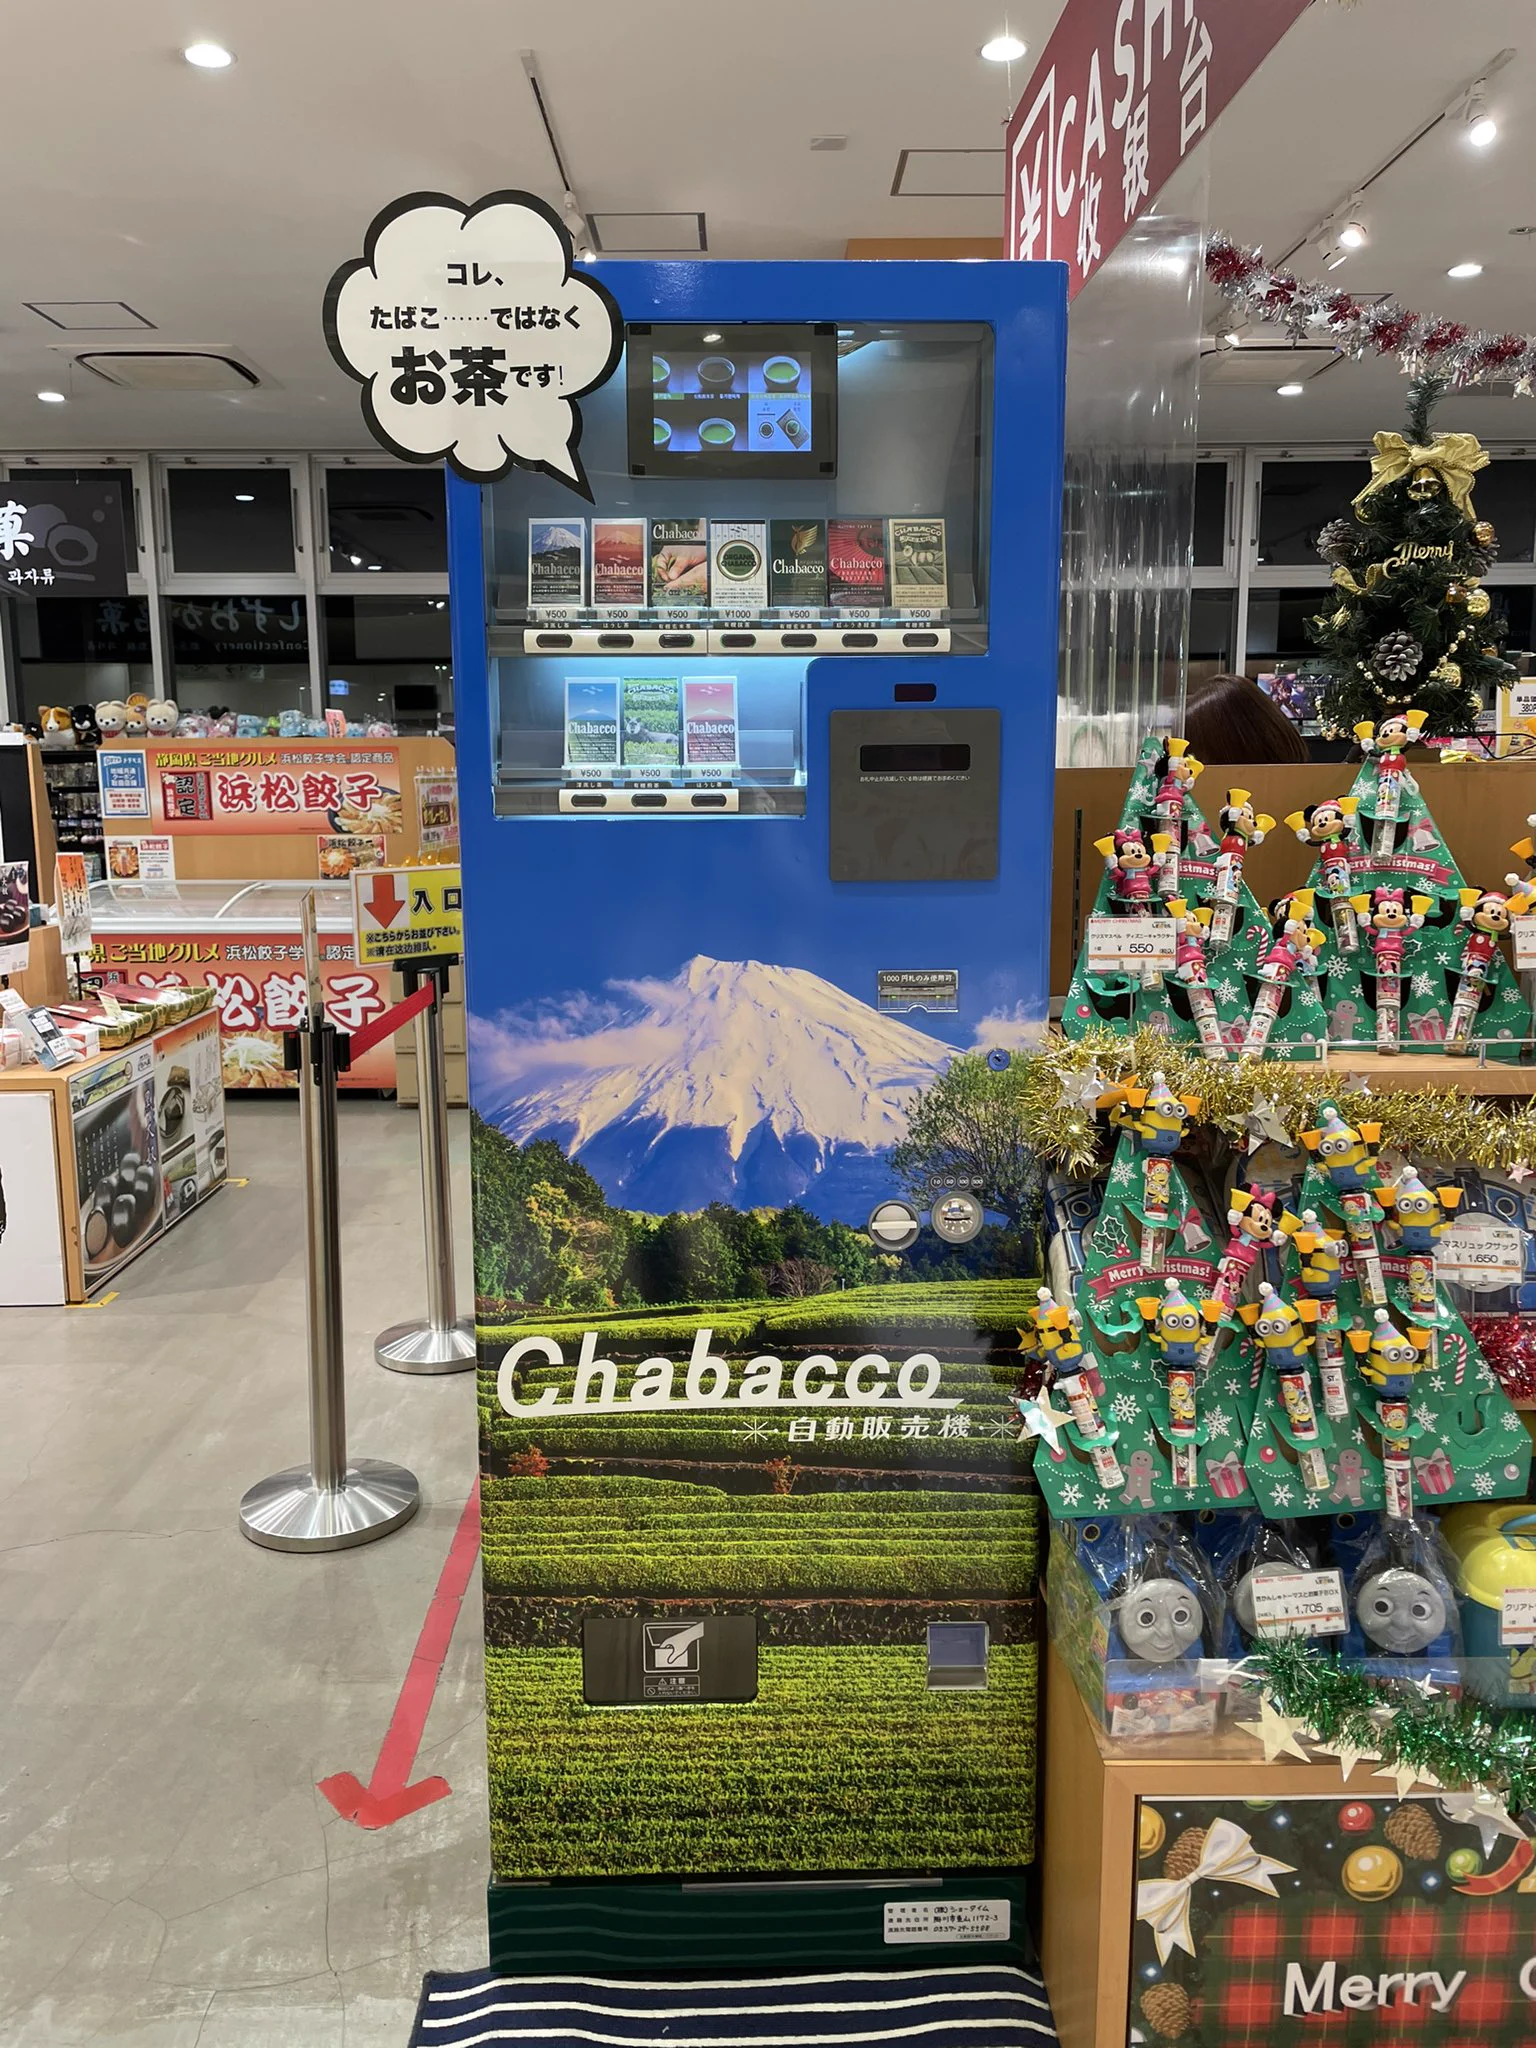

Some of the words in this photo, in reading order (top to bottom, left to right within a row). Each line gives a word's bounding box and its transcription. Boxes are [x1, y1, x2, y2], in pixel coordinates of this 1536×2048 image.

[446, 262, 505, 287] コレ、
[531, 562, 580, 576] Chabacco
[595, 562, 644, 576] Chabacco
[772, 558, 824, 574] Chabacco
[830, 557, 883, 569] Chabacco
[7, 568, 55, 586] 과자류
[545, 610, 567, 619] ¥500
[606, 610, 628, 619] ¥500
[667, 610, 689, 619] ¥500
[725, 609, 751, 619] ¥1000
[788, 610, 810, 619] ¥500
[849, 610, 870, 619] ¥500
[909, 610, 931, 619] ¥500
[568, 721, 616, 735] Chabacco
[687, 721, 735, 735] Chabacco
[580, 769, 602, 778] ¥500
[640, 769, 661, 778] ¥500
[701, 769, 722, 778] ¥500
[176, 775, 196, 817] 認定
[217, 773, 382, 812] 浜松餃子
[411, 886, 462, 916] 入口
[1129, 943, 1154, 954] 550
[1108, 1263, 1145, 1283] Merry
[496, 1329, 966, 1419] Chabacco
[787, 1414, 972, 1443] 自動販売機
[1283, 1960, 1467, 2018] Merry
